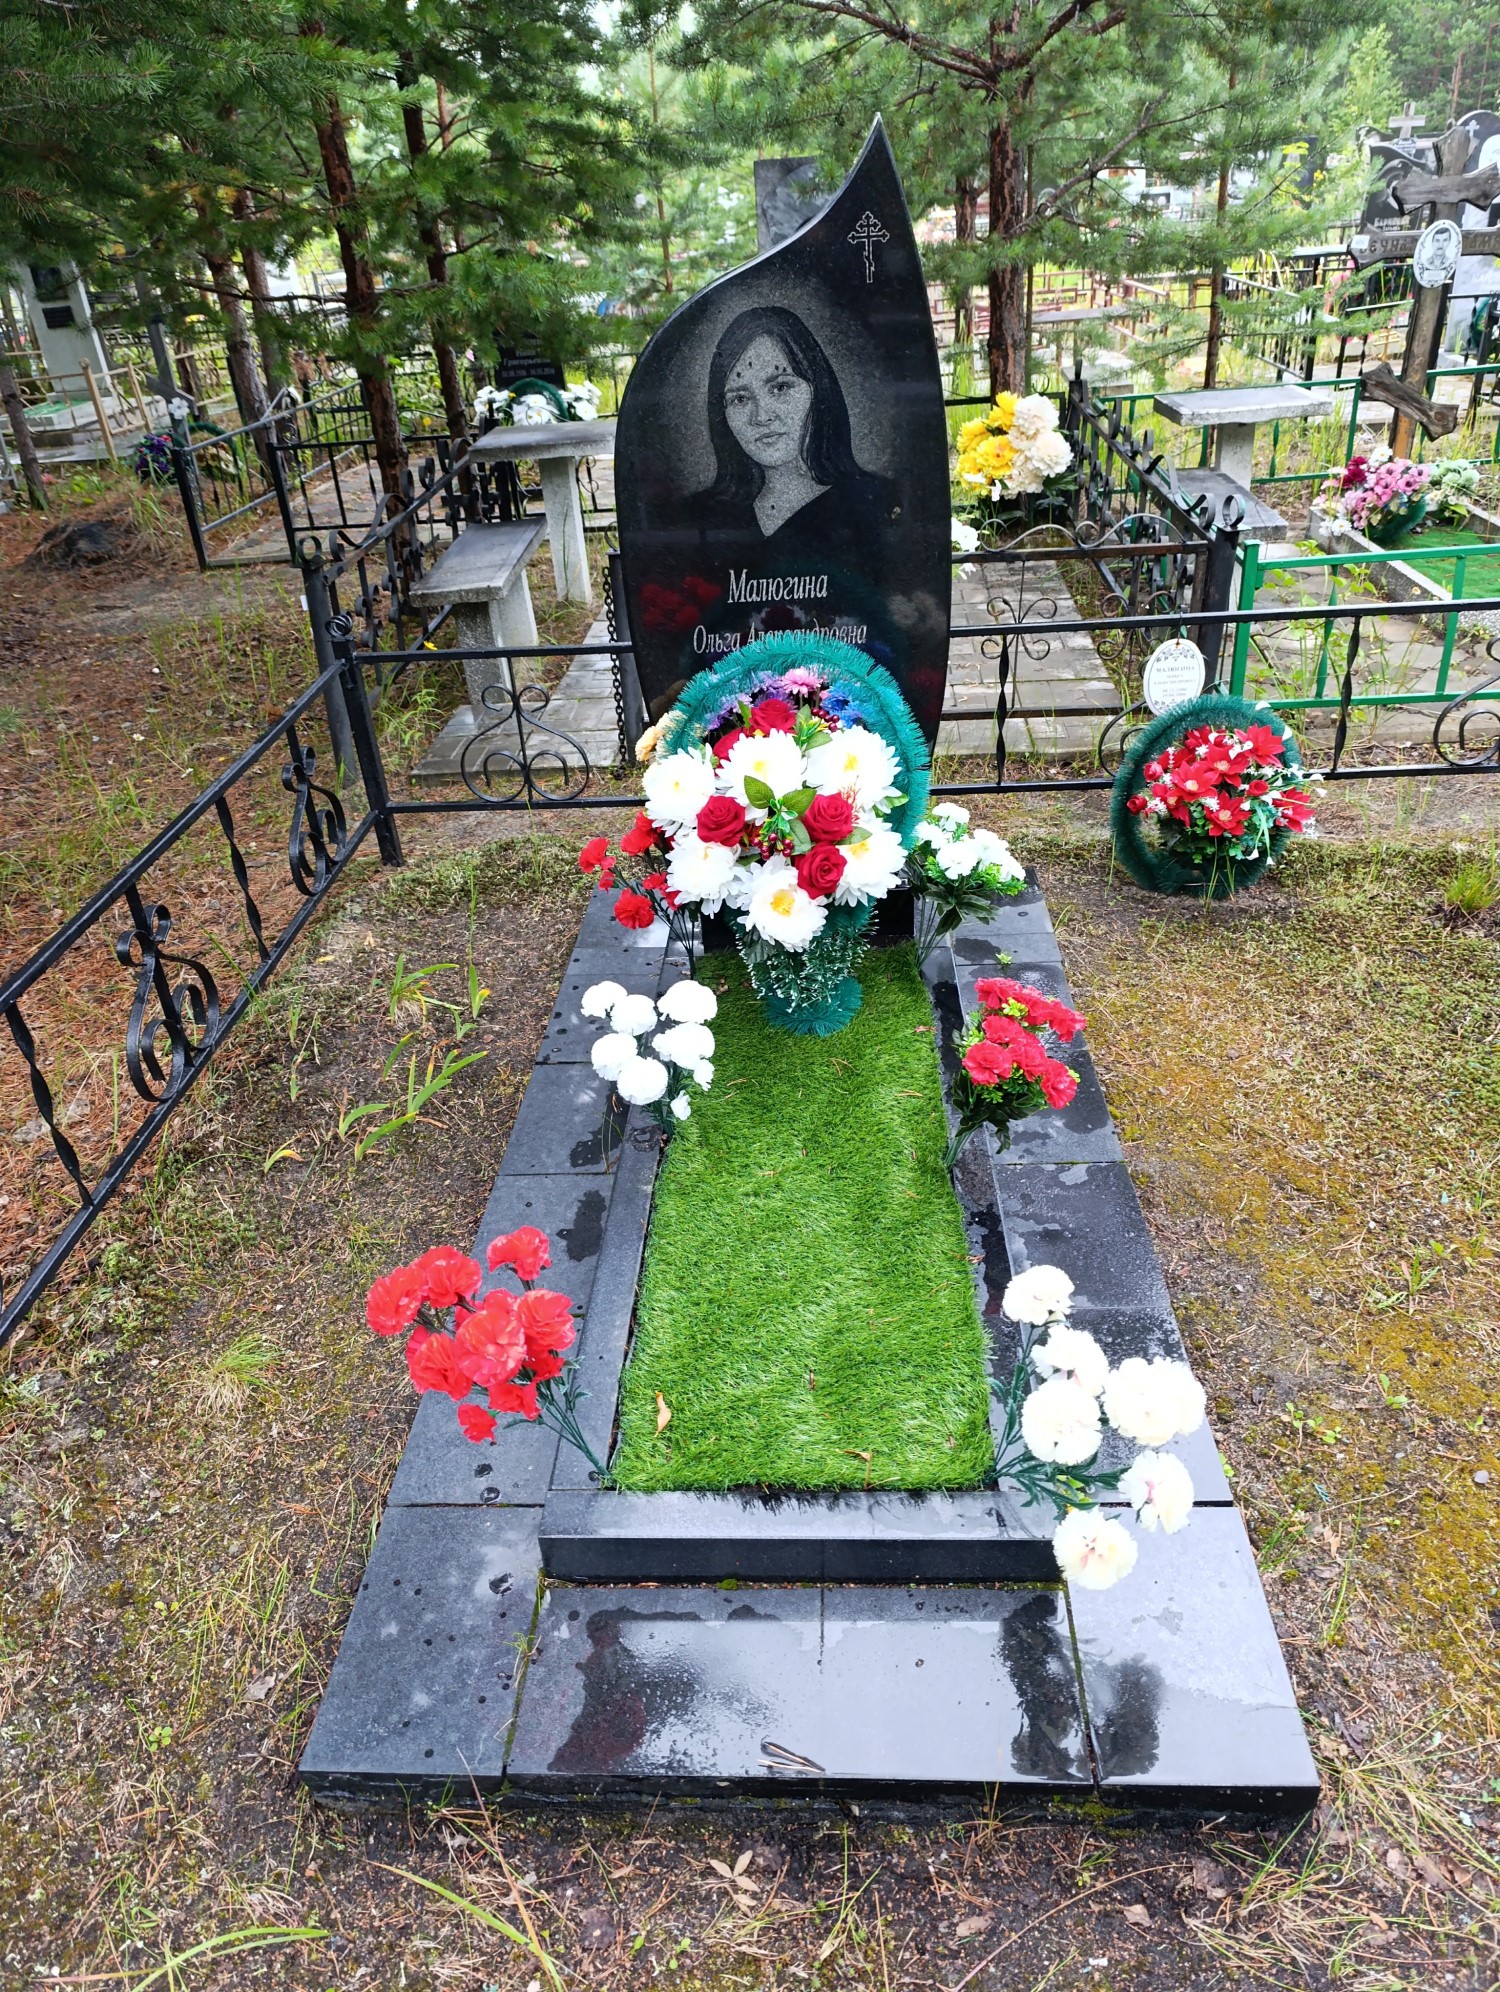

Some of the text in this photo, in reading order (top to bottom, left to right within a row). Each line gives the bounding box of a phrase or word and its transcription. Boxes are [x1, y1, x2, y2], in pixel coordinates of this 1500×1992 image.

[727, 569, 828, 604] Малюгина
[694, 617, 867, 653] Ольга Аландровна
